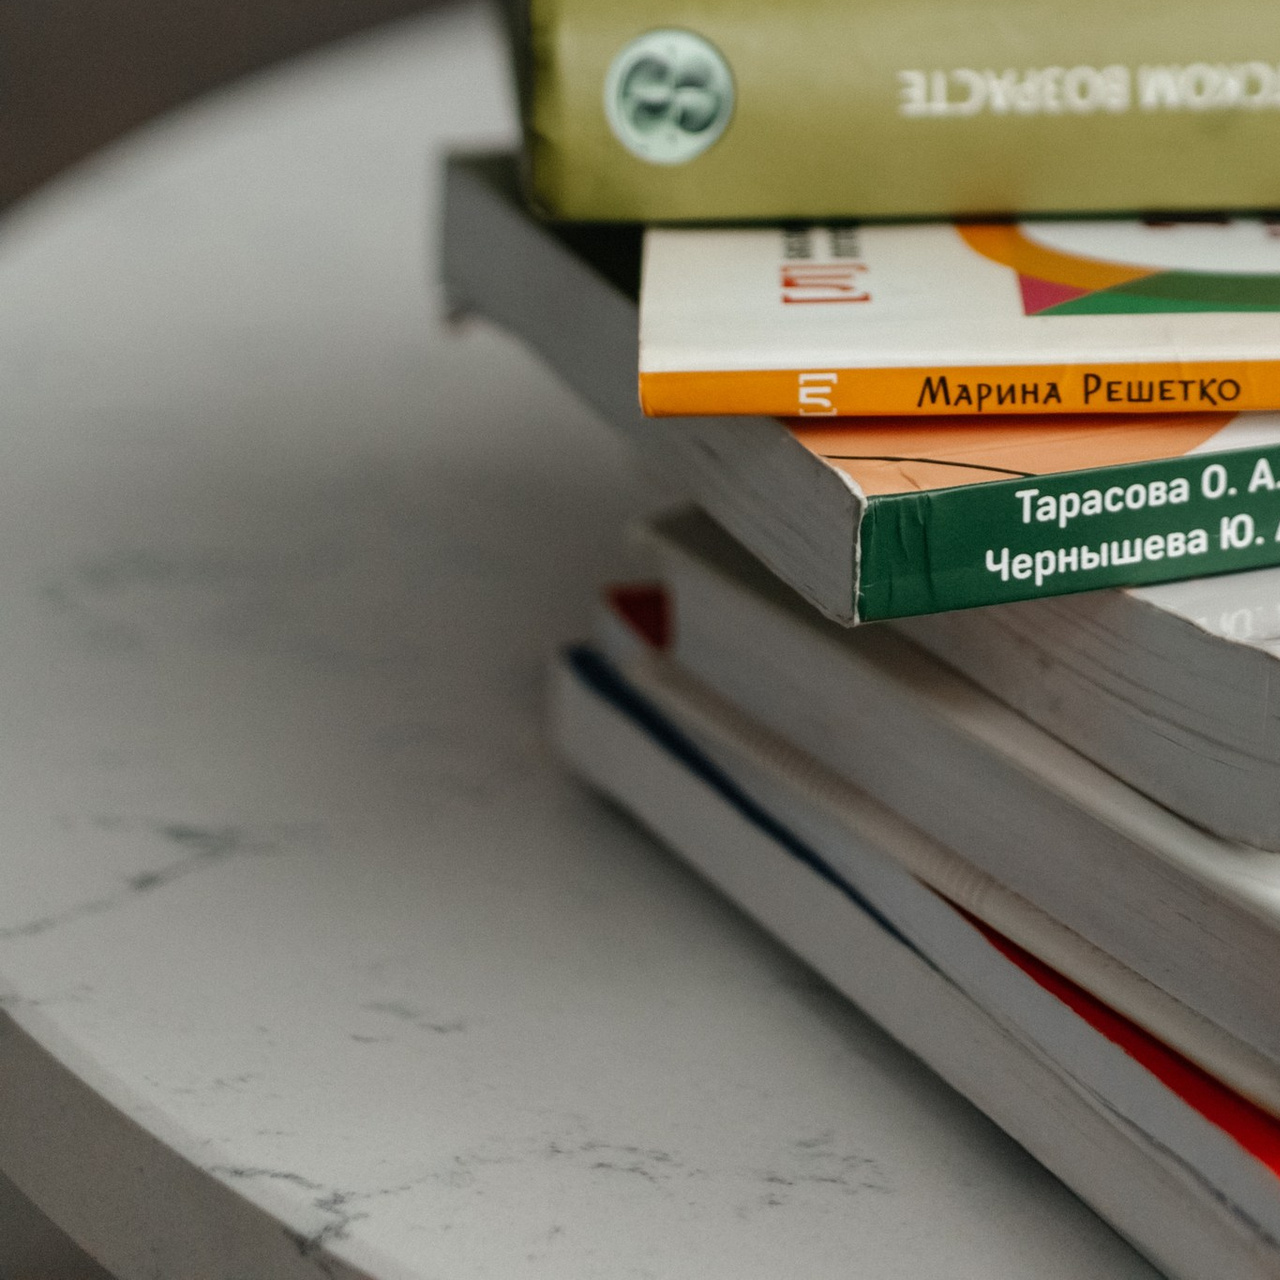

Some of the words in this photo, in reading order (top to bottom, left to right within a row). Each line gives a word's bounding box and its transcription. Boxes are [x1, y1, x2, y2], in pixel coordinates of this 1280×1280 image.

[897, 64, 1130, 118] ВОЗРАСТЕ
[1015, 477, 1190, 528] Тарасова
[1201, 463, 1238, 500] О.
[985, 526, 1208, 587] Чернышева
[1219, 512, 1265, 550] Ю.
